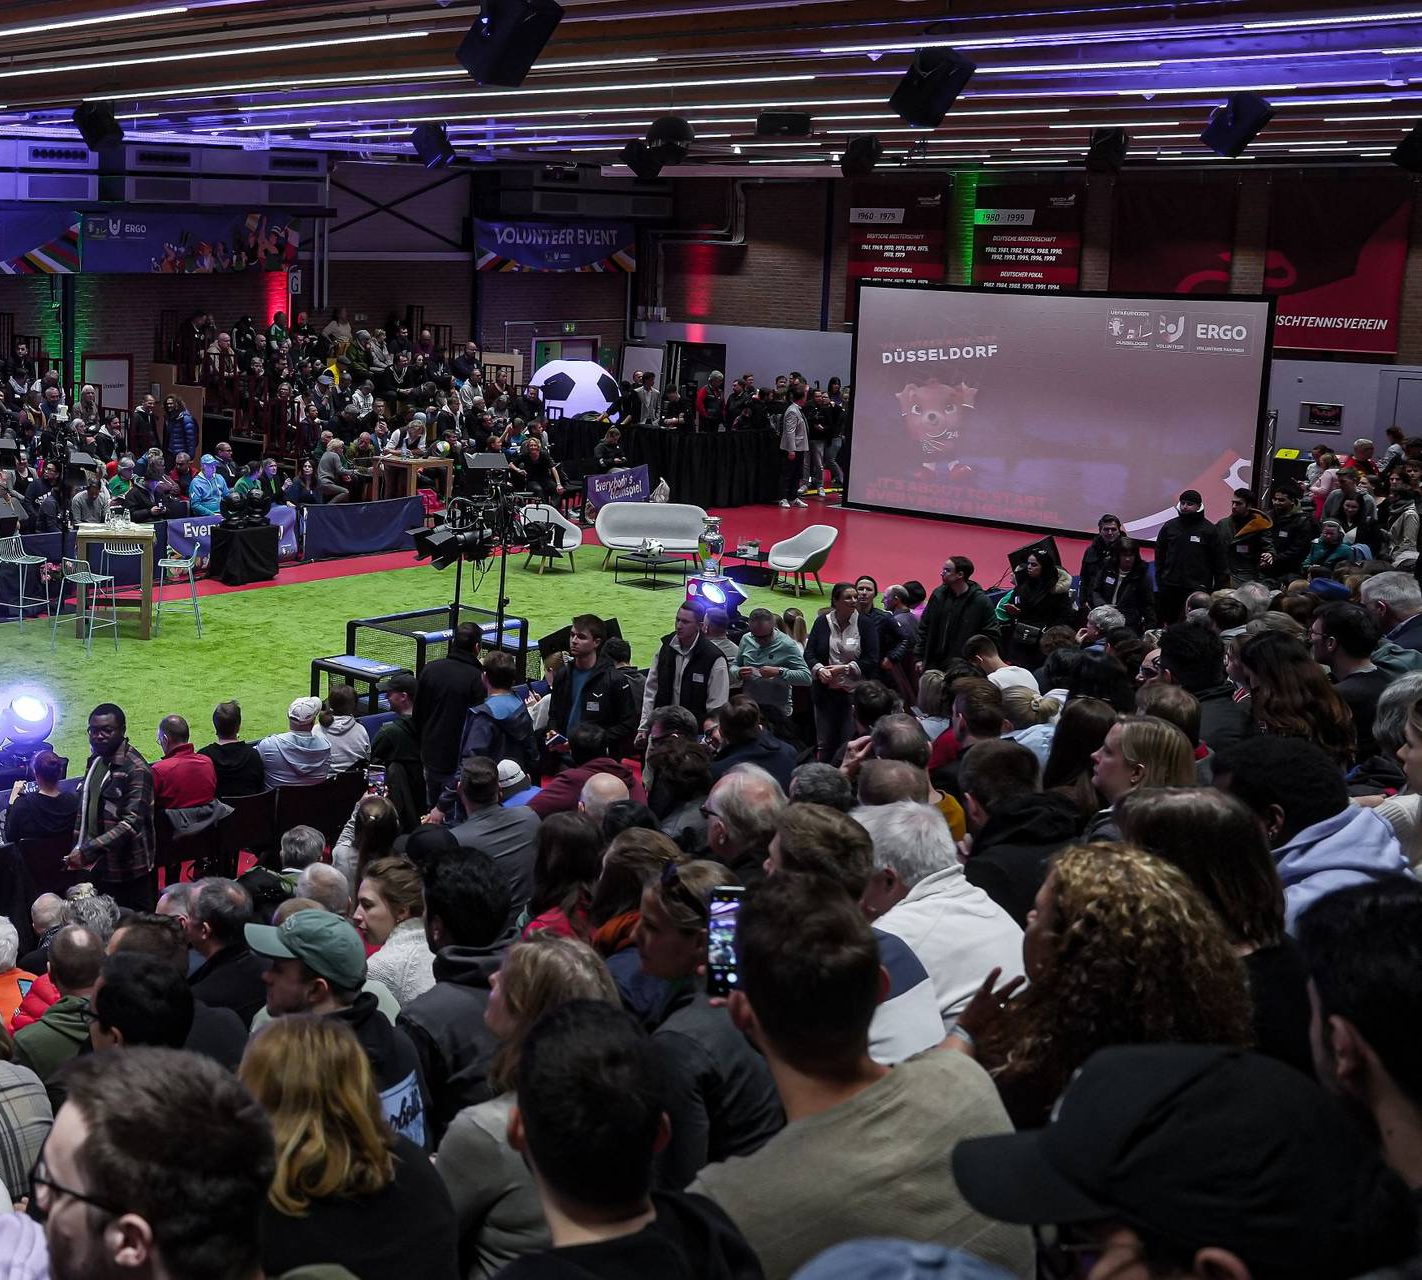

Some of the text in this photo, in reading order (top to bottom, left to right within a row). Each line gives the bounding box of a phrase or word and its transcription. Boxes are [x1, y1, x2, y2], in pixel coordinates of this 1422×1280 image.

[983, 213, 1001, 222] 1980
[1007, 213, 1025, 222] 1999
[124, 224, 147, 233] ERGO
[493, 227, 618, 246] VOLUNTEER EVENT
[1018, 235, 1057, 243] MEISTERSCHAFT
[290, 275, 299, 293] G
[1274, 314, 1388, 331] ISCHTENNISVEREIN
[1196, 323, 1248, 341] ERGO
[881, 344, 999, 364] DÜSSELDORF
[610, 480, 643, 500] Heimspiel
